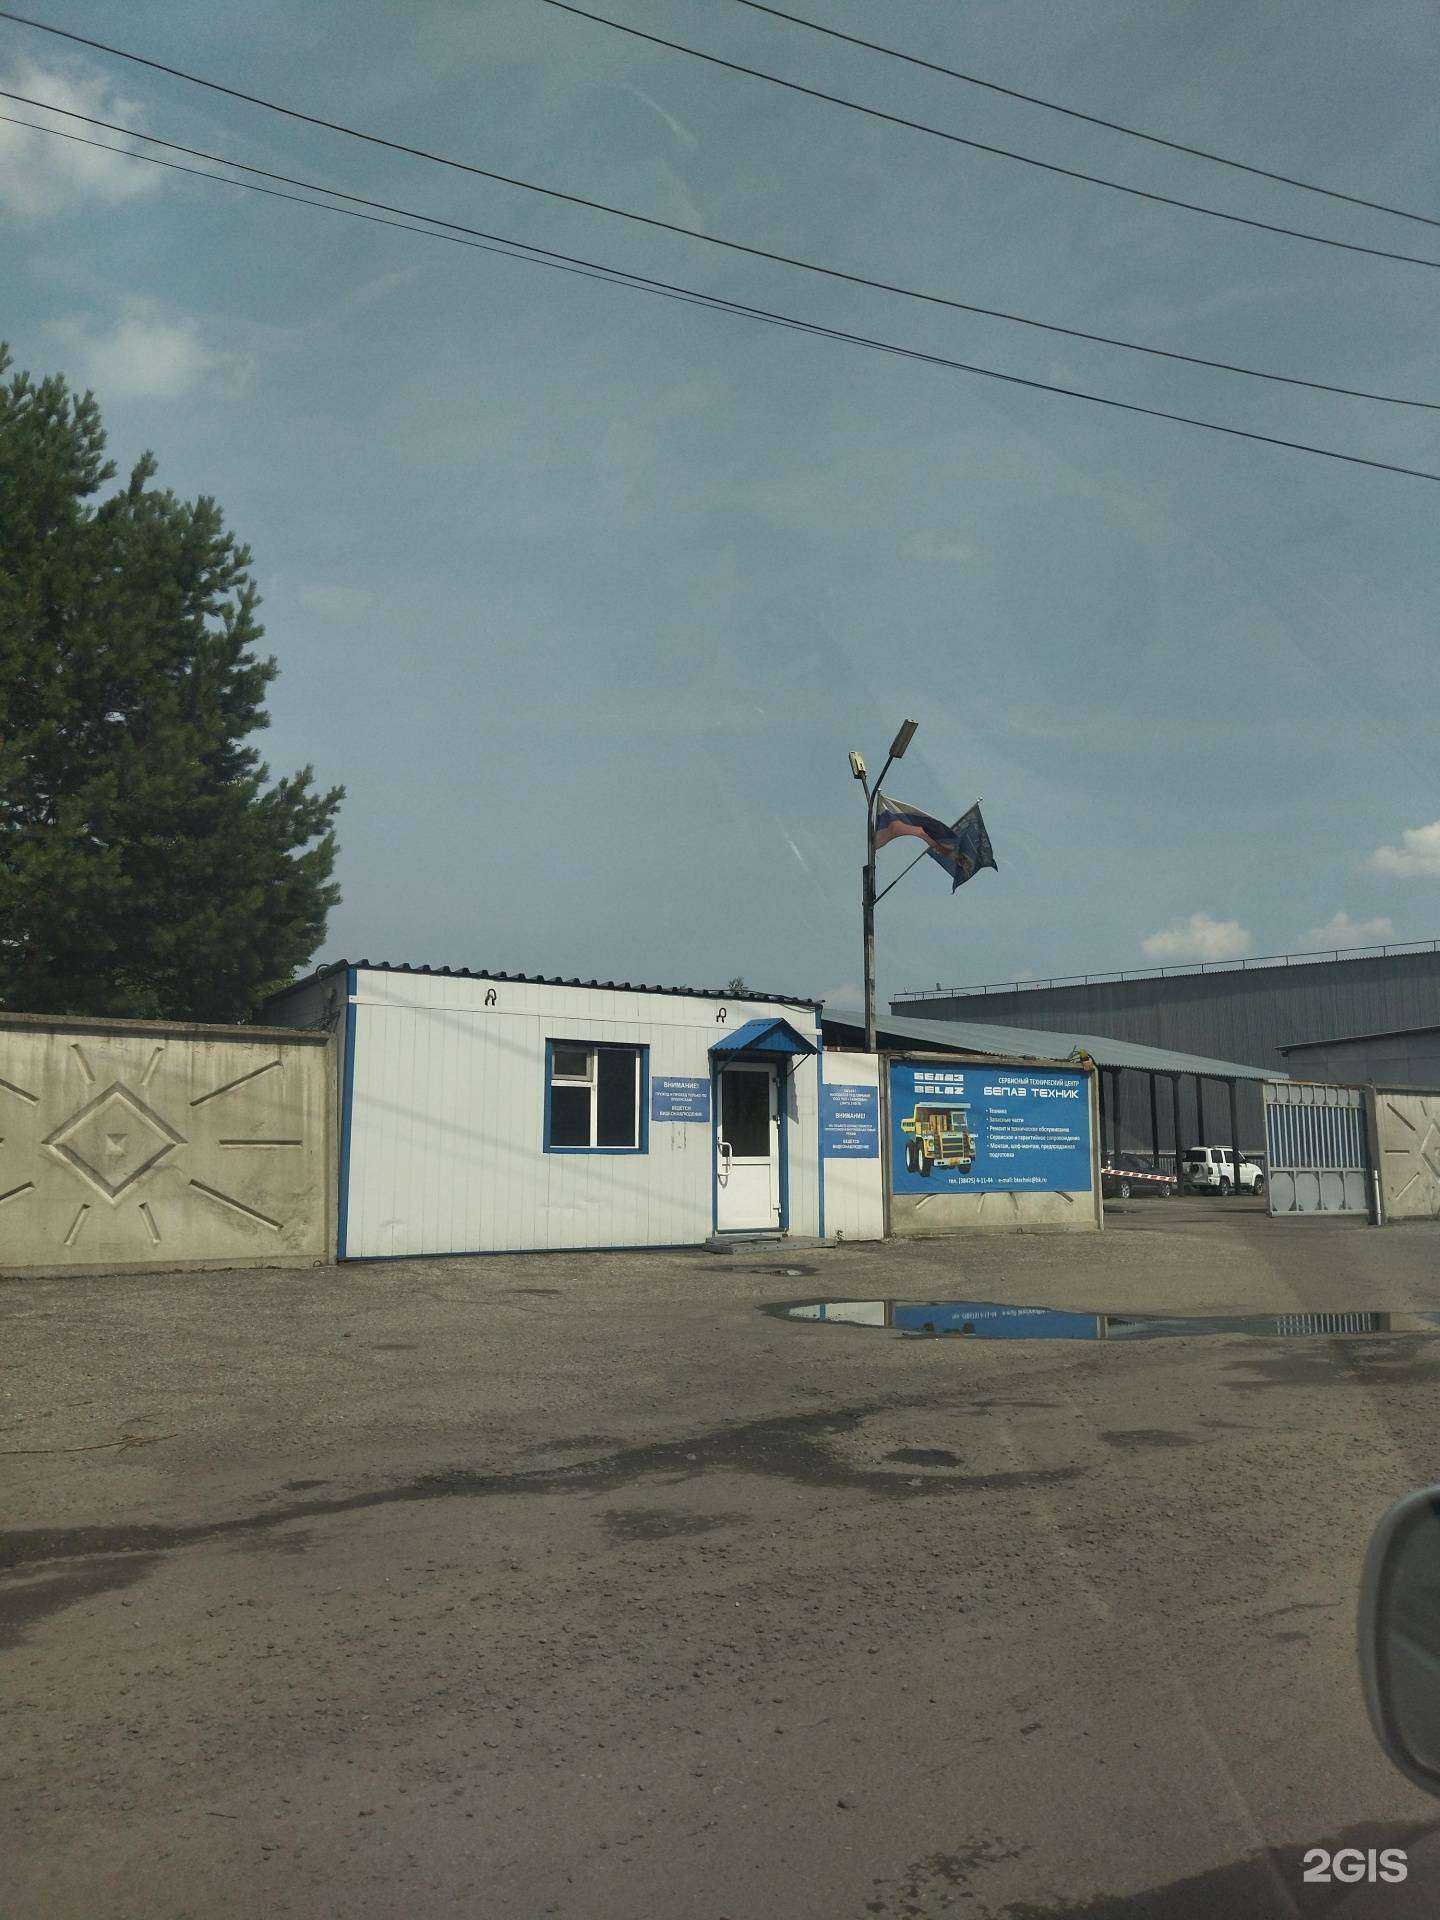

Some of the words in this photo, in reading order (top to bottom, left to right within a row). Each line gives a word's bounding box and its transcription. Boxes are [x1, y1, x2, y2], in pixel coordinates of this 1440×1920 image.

[998, 1077, 1029, 1085] СЕРВИСНЫЙ
[1029, 1079, 1064, 1087] ТЕХНИЧЕСКИЙ
[914, 1085, 964, 1095] BELAZ
[1031, 1088, 1079, 1099] ТЕХНИК
